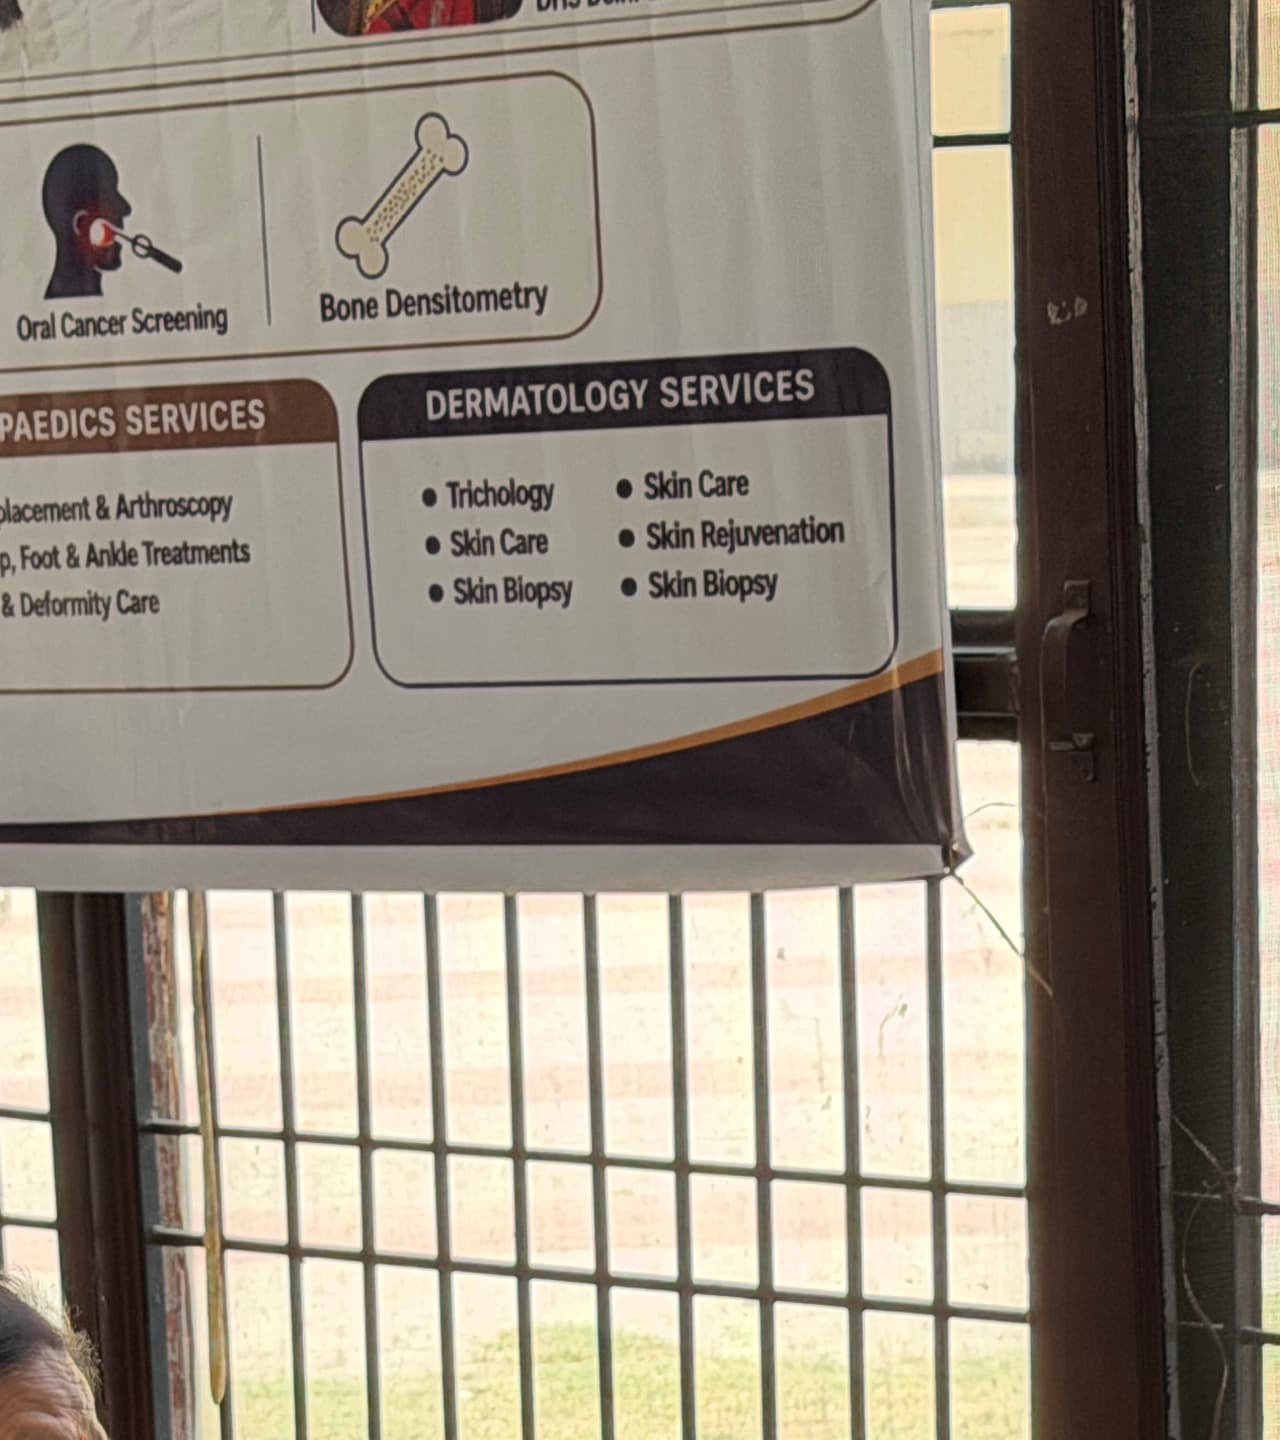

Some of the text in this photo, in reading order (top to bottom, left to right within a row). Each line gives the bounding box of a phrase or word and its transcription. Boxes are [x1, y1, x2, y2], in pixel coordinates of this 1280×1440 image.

[320, 281, 548, 324] Bone Densitometry
[17, 304, 228, 343] Oral Cancer Screening
[426, 368, 816, 422] DERMATOLOGY SERVICES
[125, 398, 266, 437] SERVICES
[445, 477, 554, 512] Trichology
[643, 469, 750, 500] Skin Care
[96, 497, 111, 520] &
[116, 491, 233, 523] Arthroscopy
[449, 527, 549, 558] Skin Care
[645, 515, 846, 555] Skin Rejuvenation
[20, 544, 61, 572] Foot
[67, 545, 81, 568] &
[86, 542, 139, 569] Ankle
[142, 538, 251, 566] Treatments
[453, 576, 573, 609] Skin Biopsy
[648, 569, 778, 604] Skin Biopsy
[1, 593, 16, 618] &
[20, 589, 111, 623] Deformity
[116, 589, 160, 616] Care
